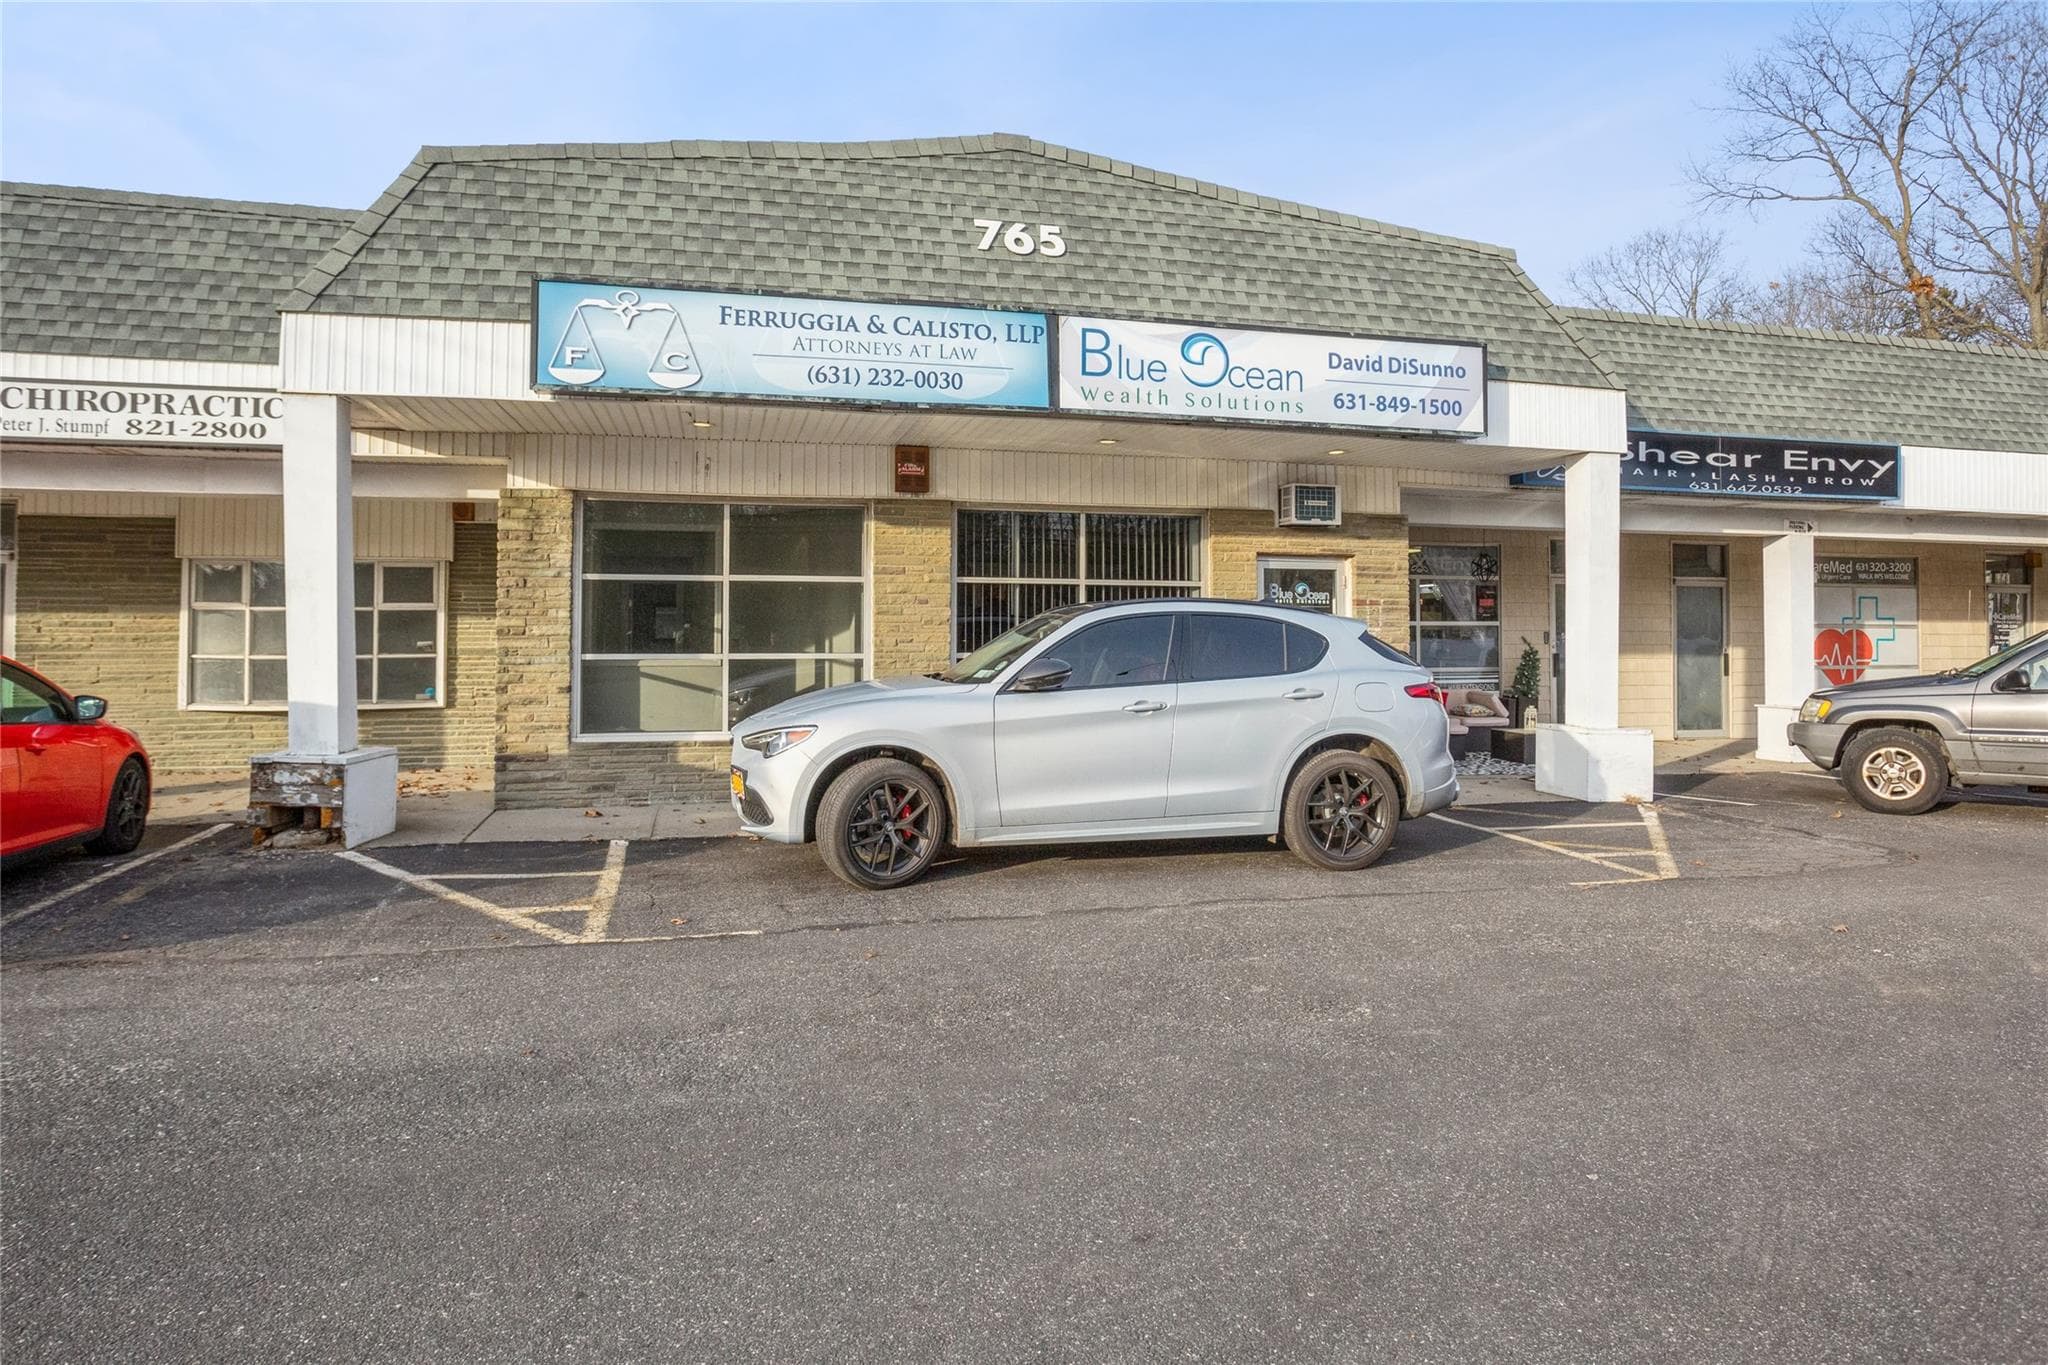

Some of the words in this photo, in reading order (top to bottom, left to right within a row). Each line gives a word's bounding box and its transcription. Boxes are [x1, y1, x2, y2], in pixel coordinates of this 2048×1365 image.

[973, 219, 1067, 257] 765
[719, 305, 860, 333] FERRUGGIA
[867, 314, 887, 334] &
[893, 316, 998, 344] CALISTO,
[1005, 323, 1045, 344] LLP
[565, 347, 588, 366] F
[792, 336, 902, 357] ATTORNEYS
[909, 345, 931, 358] AT
[940, 344, 977, 361] LAW
[1081, 327, 1167, 383] Blue
[1180, 332, 1304, 393] Ocean
[662, 352, 689, 370] C
[1328, 352, 1382, 373] David
[1388, 357, 1466, 379] DiSunno
[807, 365, 860, 387] (631)
[868, 368, 963, 390] 232-0030
[0, 386, 284, 419] CHIROPRACTIC
[1081, 386, 1168, 406] Wealth
[1185, 392, 1304, 414] Solutions
[1333, 392, 1462, 416] 631-849-1500
[0, 417, 32, 432] eter
[38, 417, 50, 435] J.
[55, 417, 110, 437] Stumpf
[125, 418, 267, 439] 821-2800
[1784, 449, 1896, 478] Envy
[1620, 467, 1677, 478] AIR
[1711, 472, 1776, 483] LASH
[1807, 476, 1875, 486] BROW
[1689, 481, 1802, 494] 631.647.0532
[1814, 561, 1853, 573] areMed
[1856, 563, 1868, 571] 631
[1869, 562, 1911, 572] 320-3200
[1270, 583, 1293, 599] Blue
[1294, 582, 1330, 600] Ocean
